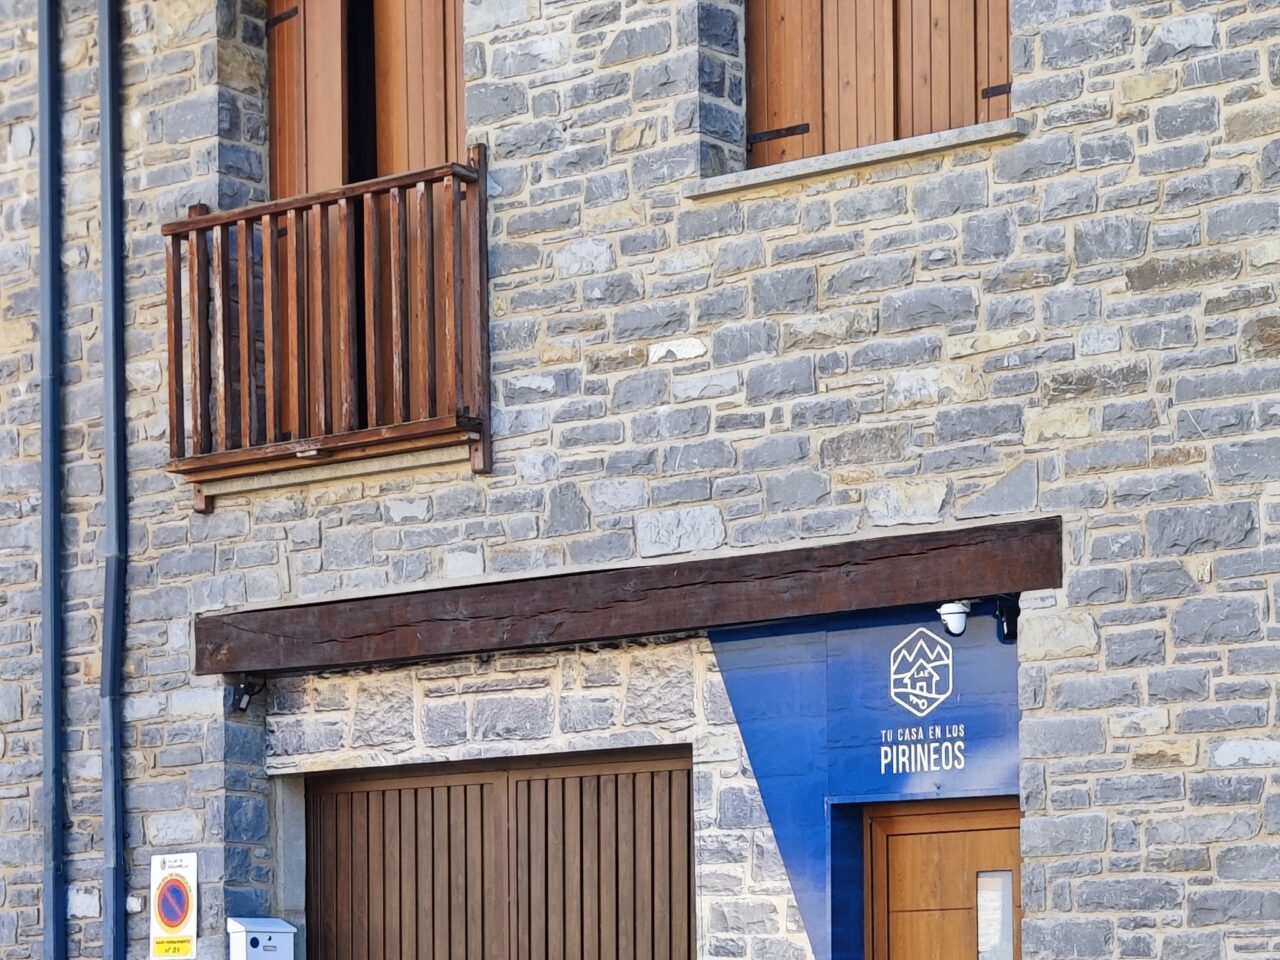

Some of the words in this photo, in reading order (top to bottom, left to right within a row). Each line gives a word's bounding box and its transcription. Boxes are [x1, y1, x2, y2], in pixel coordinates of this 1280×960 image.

[881, 729, 893, 742] TU
[898, 726, 924, 741] CASA
[928, 724, 941, 739] EN
[946, 724, 965, 738] LOS
[880, 740, 965, 775] PIRINEOS
